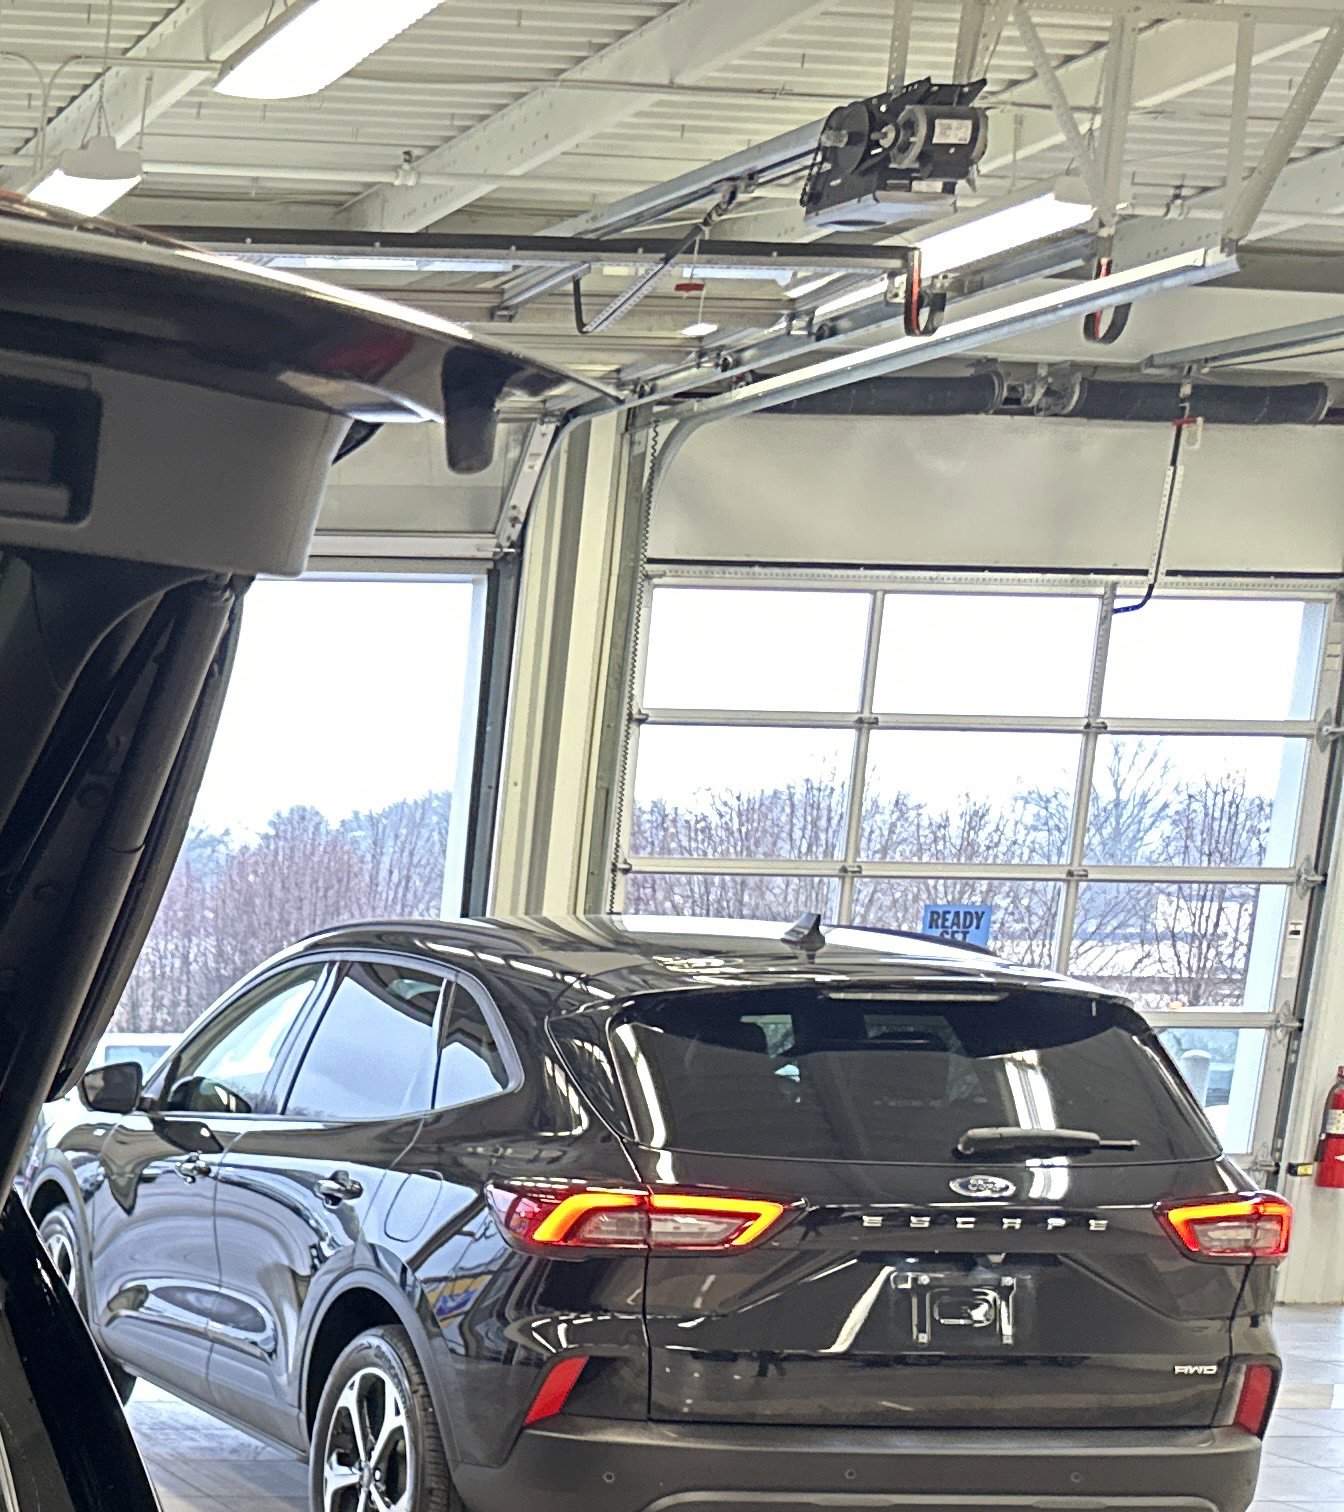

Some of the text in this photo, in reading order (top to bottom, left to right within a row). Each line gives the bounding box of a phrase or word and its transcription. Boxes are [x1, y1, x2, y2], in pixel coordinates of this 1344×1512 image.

[928, 910, 985, 929] READY
[862, 1215, 1108, 1231] ESCAPE
[1174, 1366, 1217, 1374] AWD
